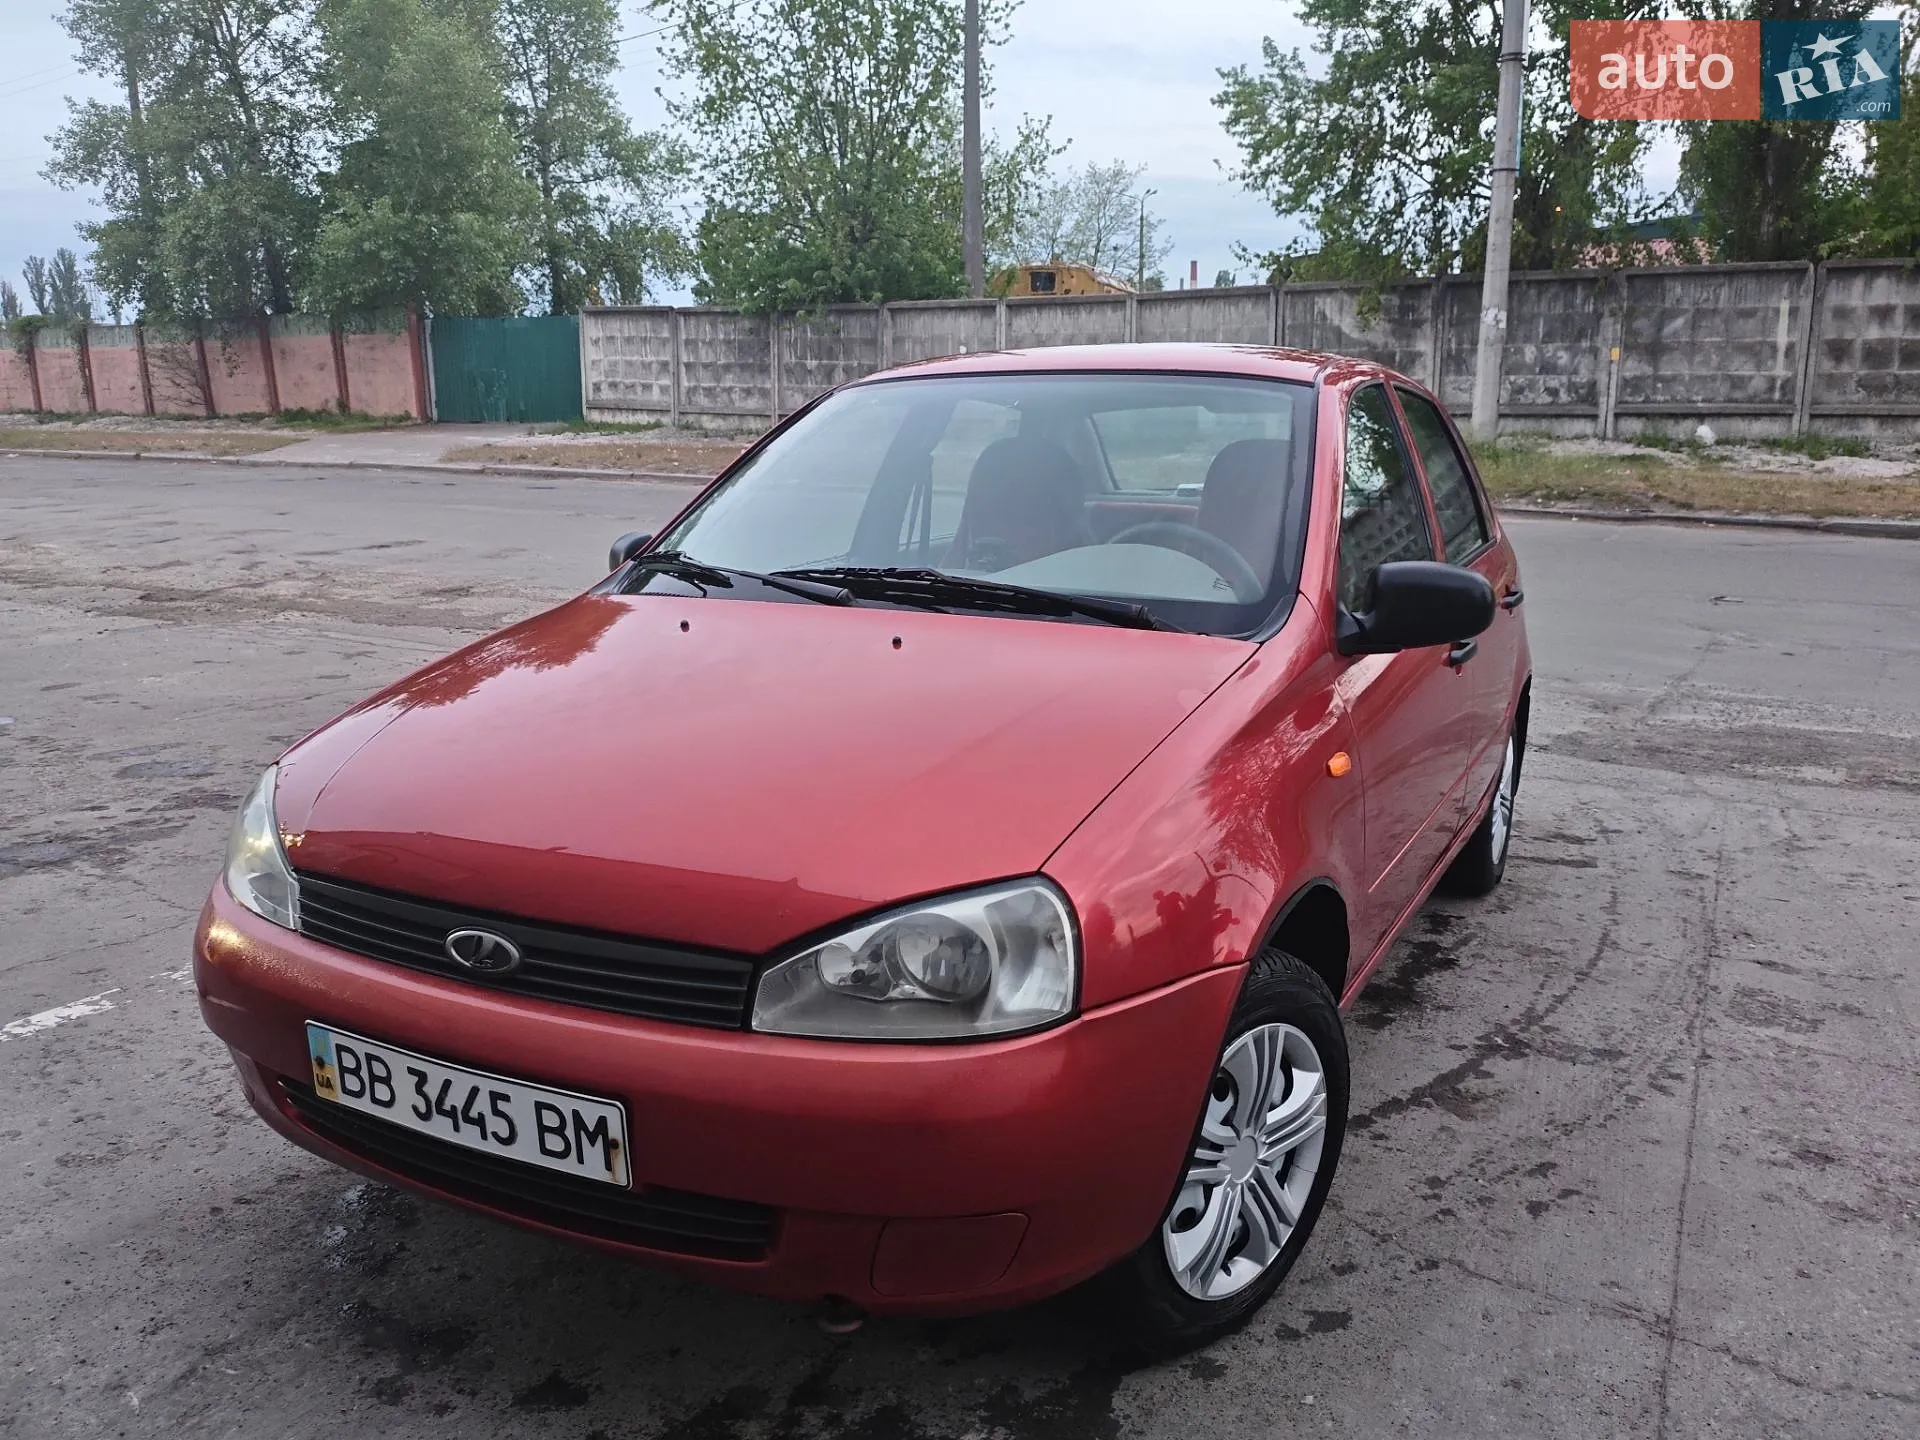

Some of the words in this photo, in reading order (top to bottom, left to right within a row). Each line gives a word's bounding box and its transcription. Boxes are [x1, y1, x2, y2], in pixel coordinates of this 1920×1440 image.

[315, 1073, 335, 1091] UA
[335, 1043, 396, 1108] BB
[406, 1066, 518, 1146] 3445
[534, 1100, 613, 1172] BM
